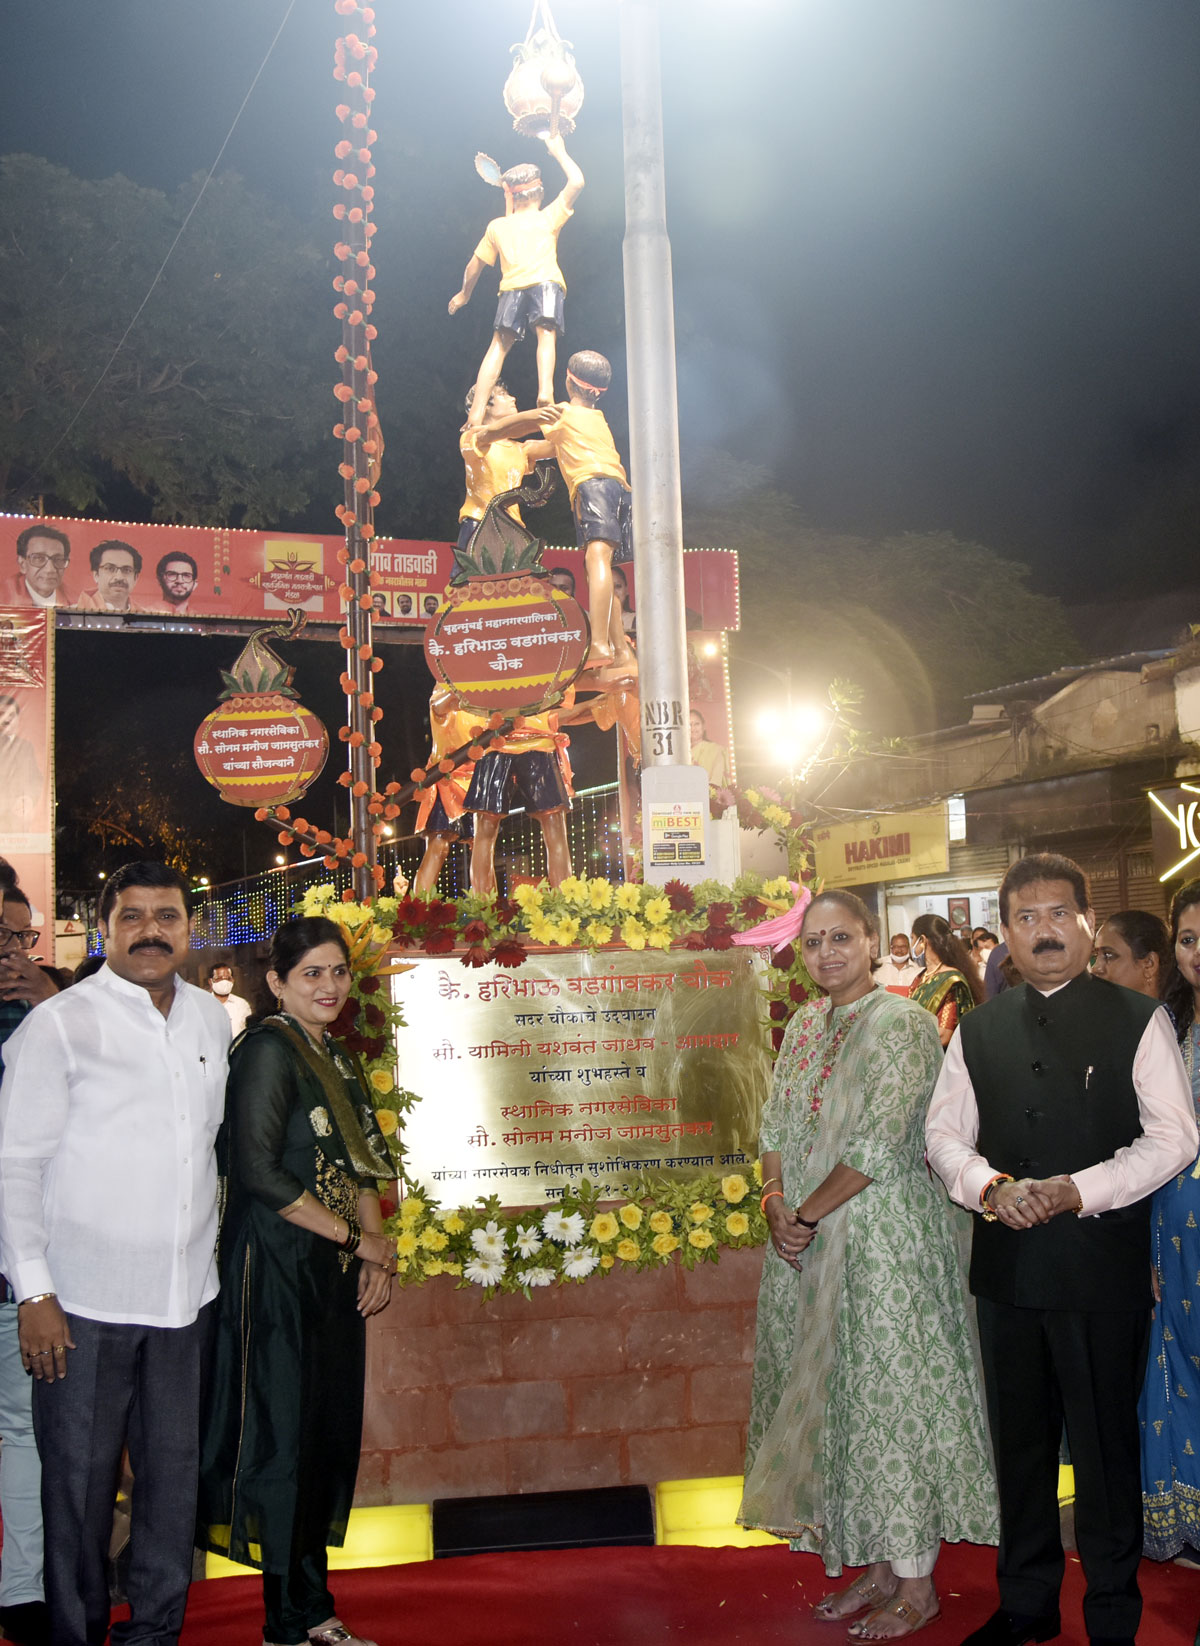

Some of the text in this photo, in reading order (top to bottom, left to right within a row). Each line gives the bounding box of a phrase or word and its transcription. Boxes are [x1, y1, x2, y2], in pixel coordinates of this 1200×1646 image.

[394, 549, 437, 574] ताडवाडी
[443, 612, 557, 635] बृहन्मुंबई महानगरपालिका
[428, 627, 582, 656] कै. हरिभाऊ वडगांवकर
[488, 653, 523, 671] चौक
[645, 701, 683, 726] NBR
[212, 724, 299, 739] स्थानिक नगरसेविका
[653, 731, 673, 756] 31
[197, 739, 320, 754] सौ. सोनम मनोज जामसुतकर
[223, 755, 295, 771] यांच्या सौजन्याने
[653, 816, 699, 827] miBEST
[844, 832, 911, 865] HAKIMI
[438, 959, 733, 1001] कै. हरिभाऊ वडगांवकर चौक
[514, 1013, 544, 1028] सदर
[548, 1005, 597, 1025] चौकाचे
[432, 1038, 462, 1061] सौ.
[468, 1039, 531, 1059] यामिनी
[536, 1033, 597, 1057] यशवंत
[601, 1037, 656, 1053] जाधव
[675, 1033, 739, 1050] आमदार
[529, 1061, 647, 1085] यांच्या शुभहस्ते व
[500, 1094, 679, 1120] स्थानिक नगरसेविका
[467, 1120, 713, 1147] सौ. सोनम मनोज जामसुतकर
[431, 1149, 751, 1182] यांच्या नगरसेवक निधीतून सुशोभिकरण करण्यात आले.
